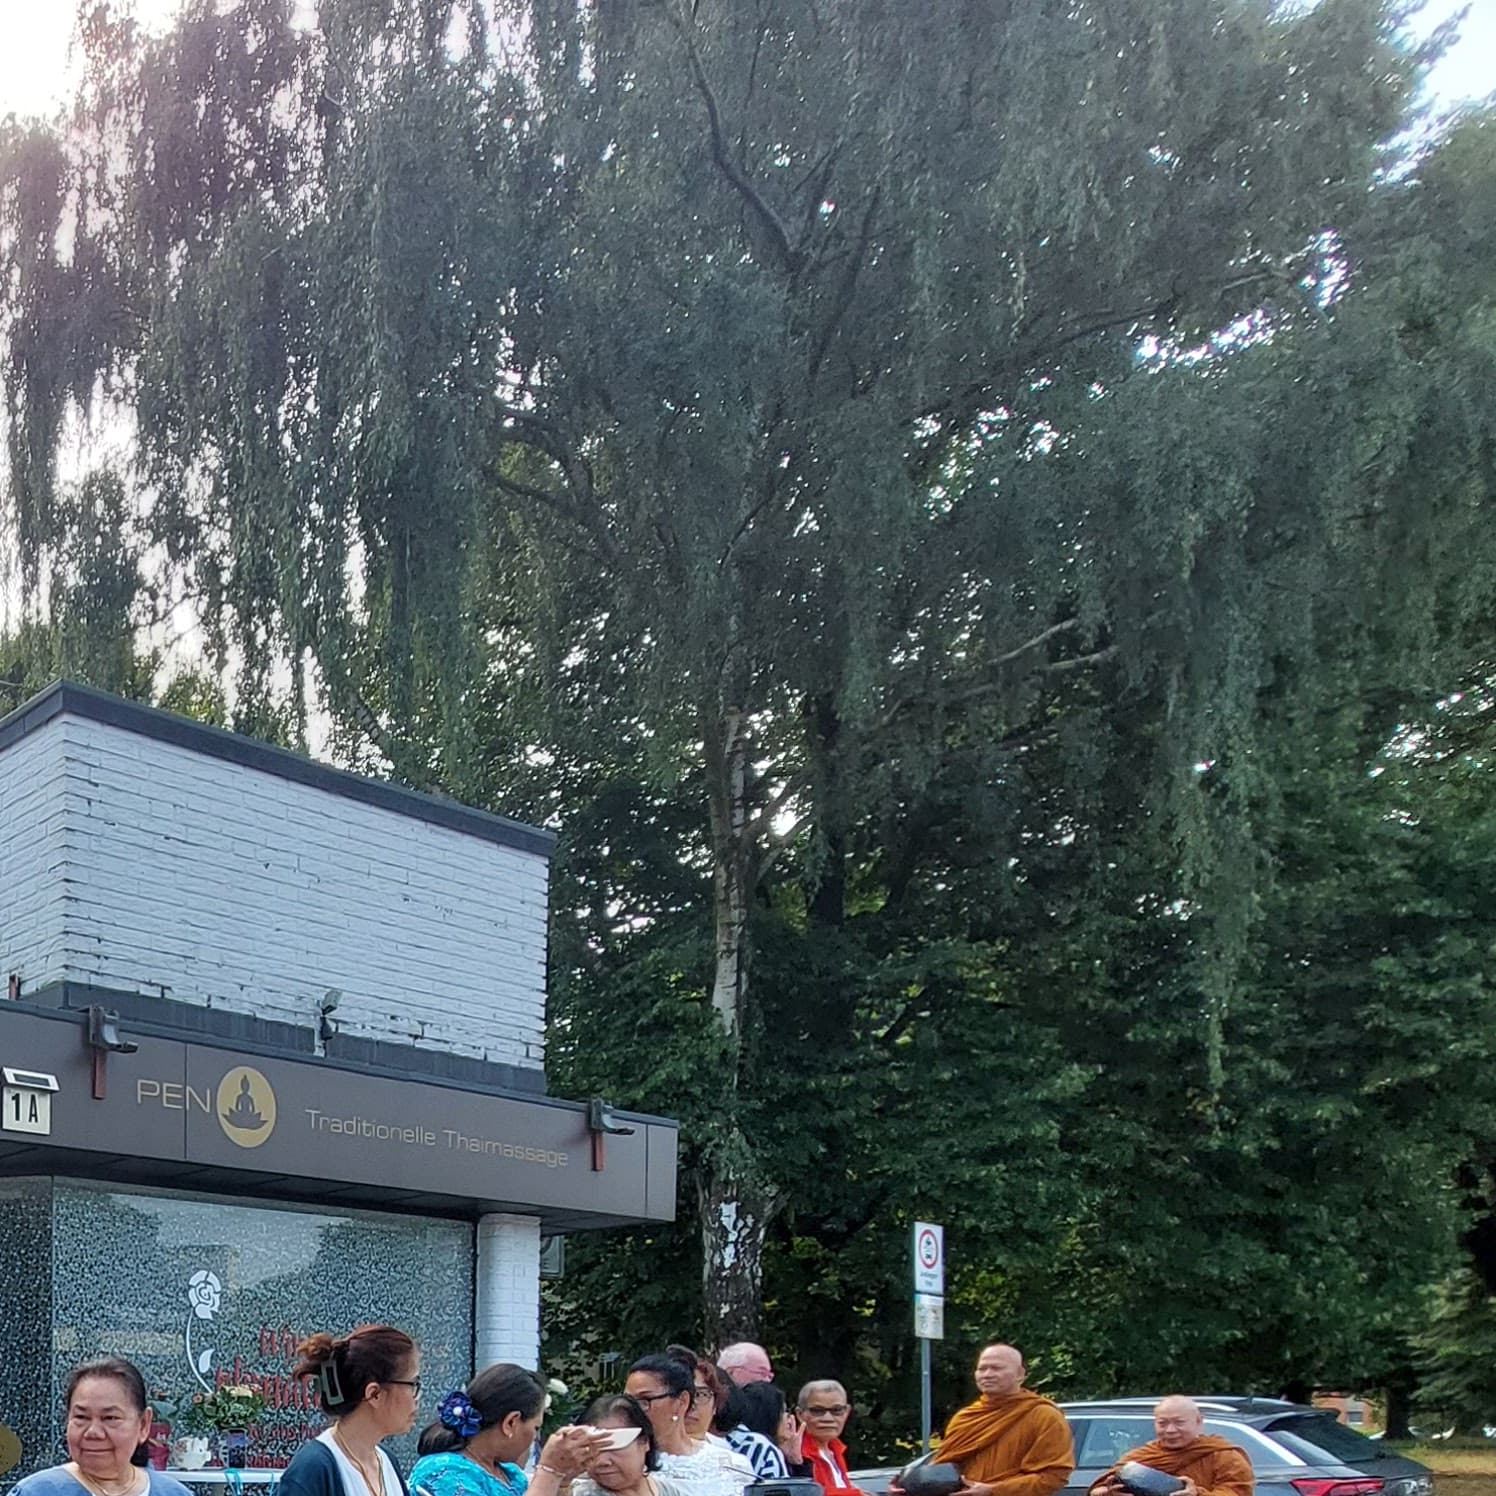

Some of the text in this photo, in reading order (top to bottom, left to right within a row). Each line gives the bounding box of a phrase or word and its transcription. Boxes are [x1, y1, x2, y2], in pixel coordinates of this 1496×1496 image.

[136, 1079, 210, 1113] PEN
[305, 1109, 569, 1168] Traditionelle Thaimassage
